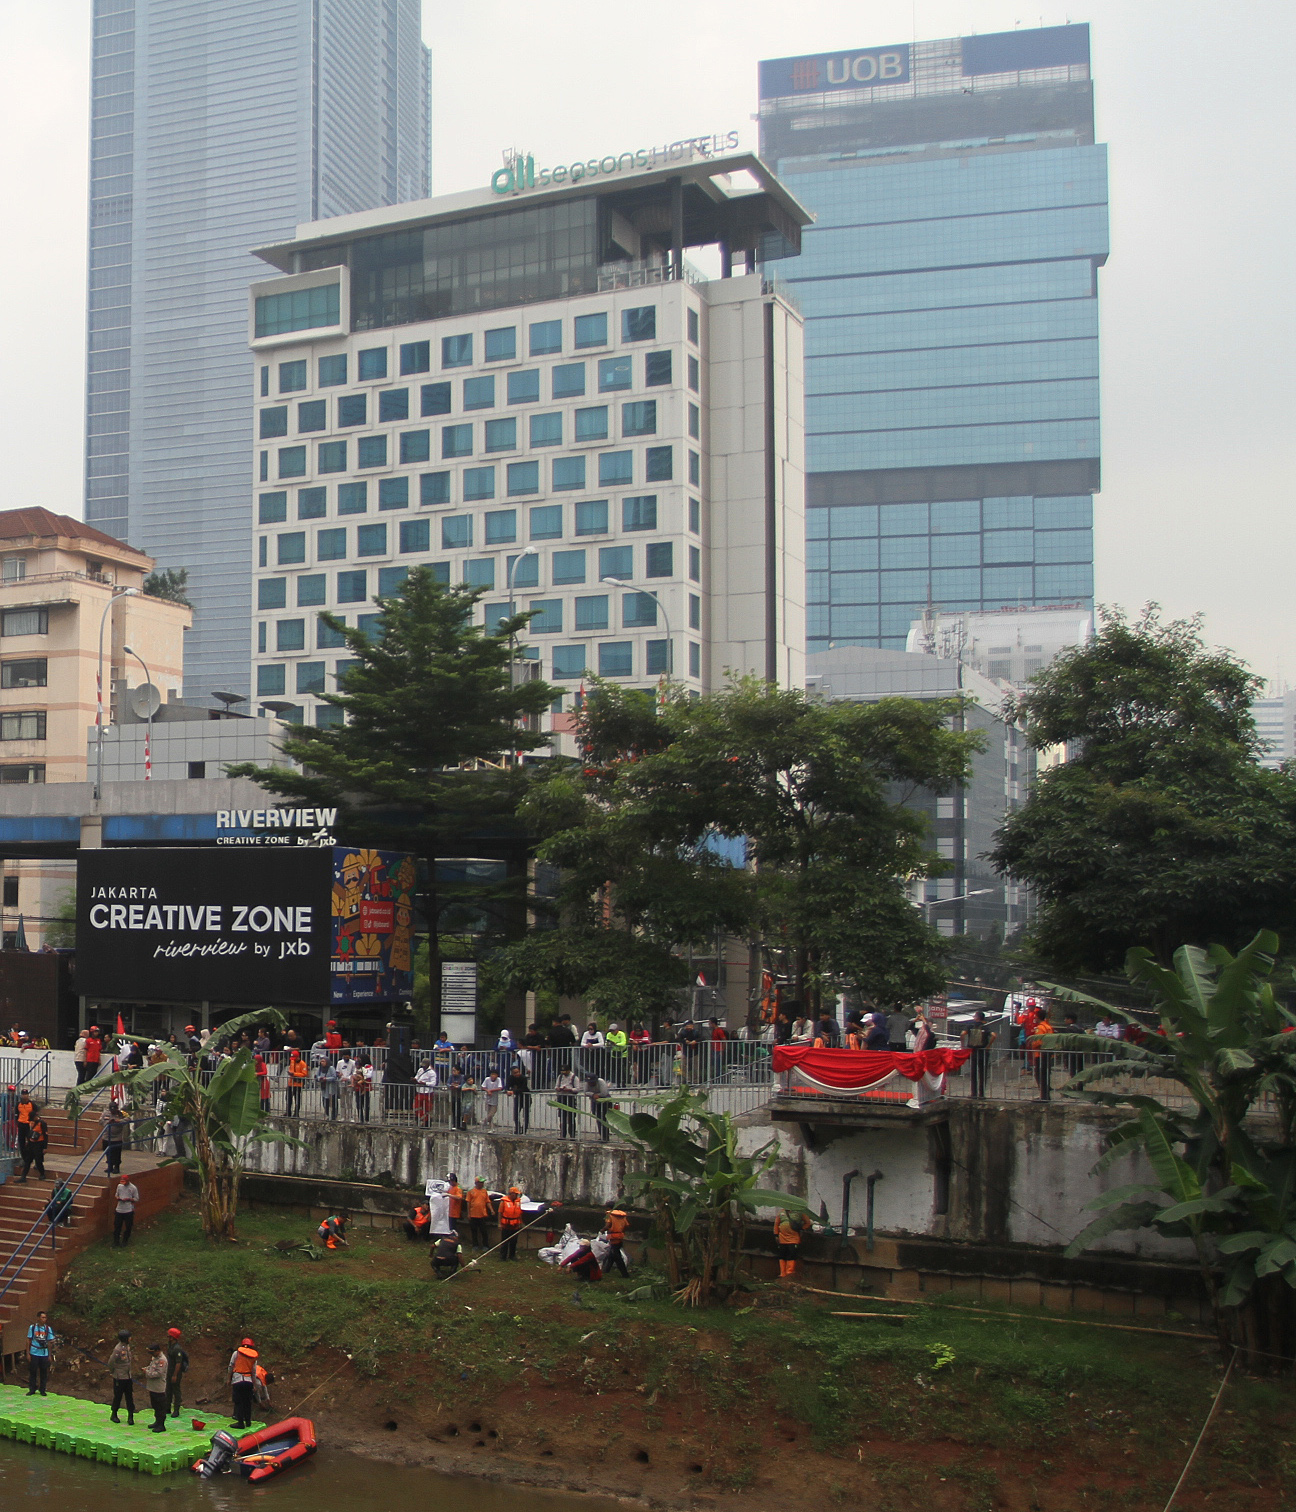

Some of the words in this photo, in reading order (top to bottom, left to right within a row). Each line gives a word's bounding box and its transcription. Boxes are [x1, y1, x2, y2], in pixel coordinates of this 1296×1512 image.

[825, 53, 903, 85] UOB
[651, 130, 739, 164] HOTELS
[216, 807, 338, 828] RIVERVIEW
[216, 836, 261, 845] CREATIVE
[264, 836, 290, 844] ZONE
[297, 836, 309, 847] by
[319, 836, 337, 848] jxb
[90, 886, 158, 899] JAKARTA
[89, 903, 222, 931] CREATIVE
[231, 905, 312, 933] ZONE
[153, 938, 248, 958] riverview
[254, 942, 271, 957] by
[278, 938, 311, 960] jxb
[333, 990, 343, 998] New
